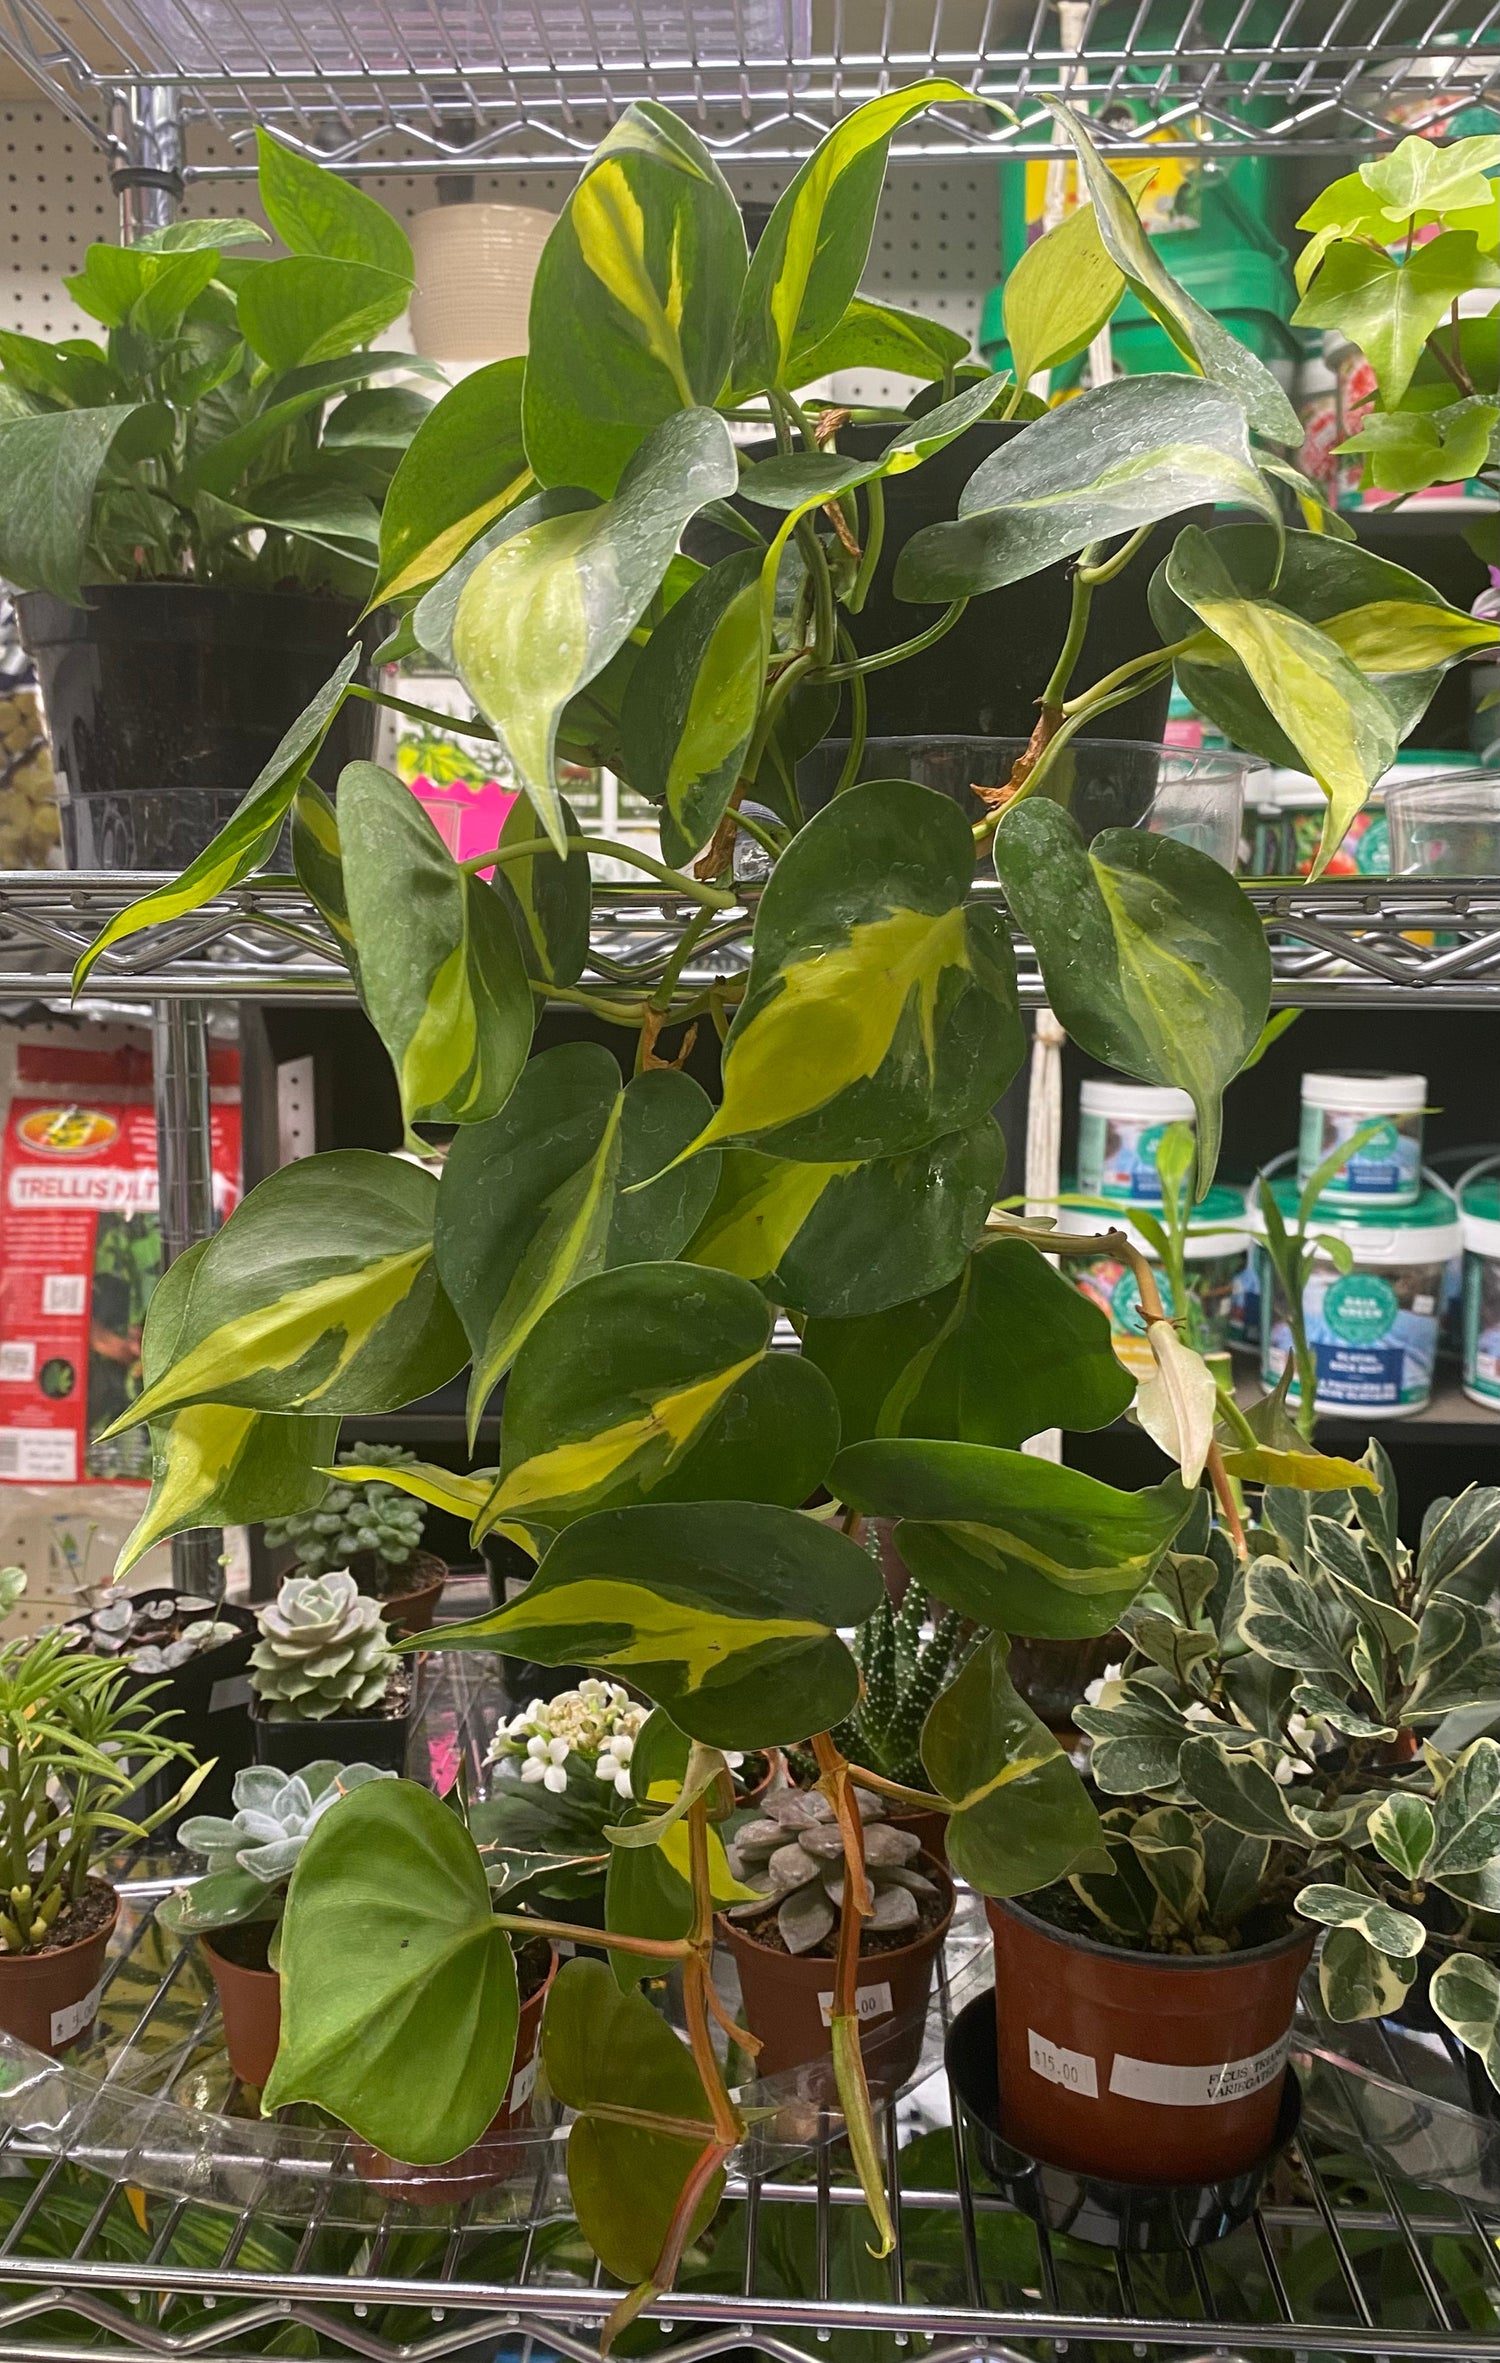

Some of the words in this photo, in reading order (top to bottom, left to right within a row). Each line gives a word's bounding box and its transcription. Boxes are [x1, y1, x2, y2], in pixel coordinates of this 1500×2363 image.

[18, 1176, 108, 1199] TRELLIS
[1034, 2050, 1078, 2083] $15.00
[1208, 2067, 1248, 2085] FICUS
